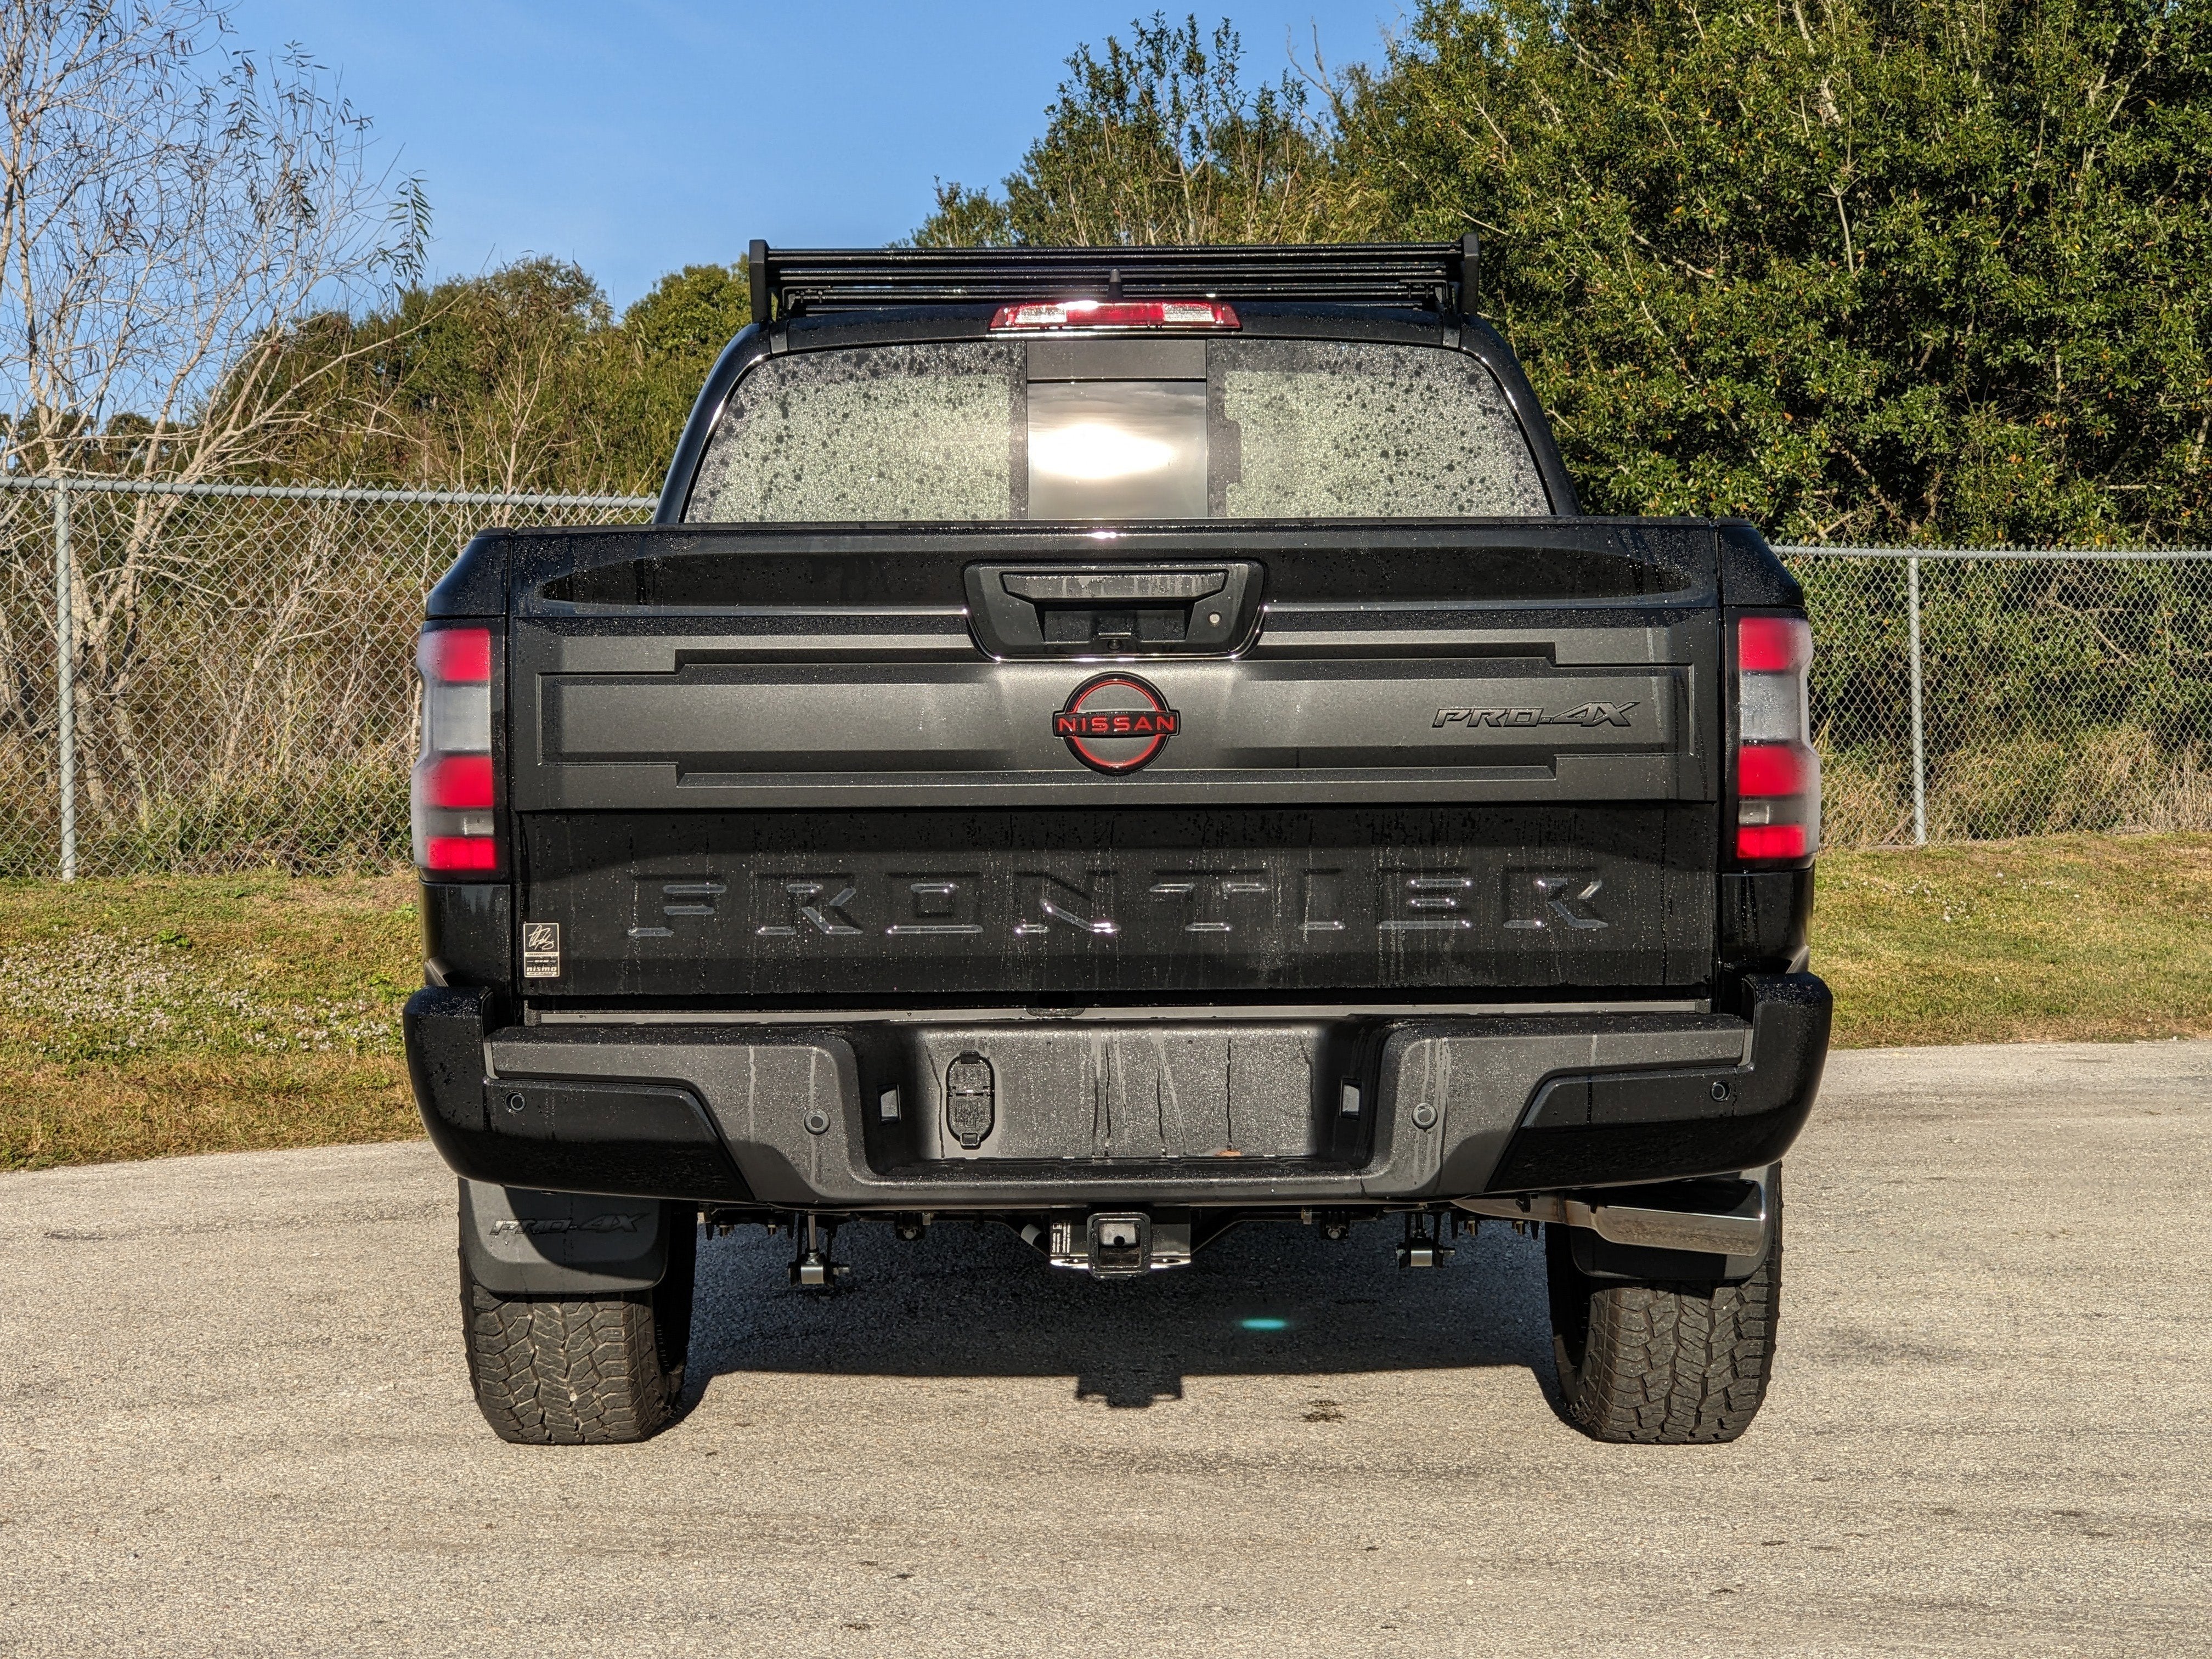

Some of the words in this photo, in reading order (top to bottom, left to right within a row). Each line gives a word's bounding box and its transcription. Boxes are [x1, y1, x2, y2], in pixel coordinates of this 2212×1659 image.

[1058, 716, 1175, 732] NISSAN
[1432, 702, 1641, 727] PRO-4X
[627, 867, 1610, 937] FRONTIER
[489, 1212, 650, 1235] PRO-4X
